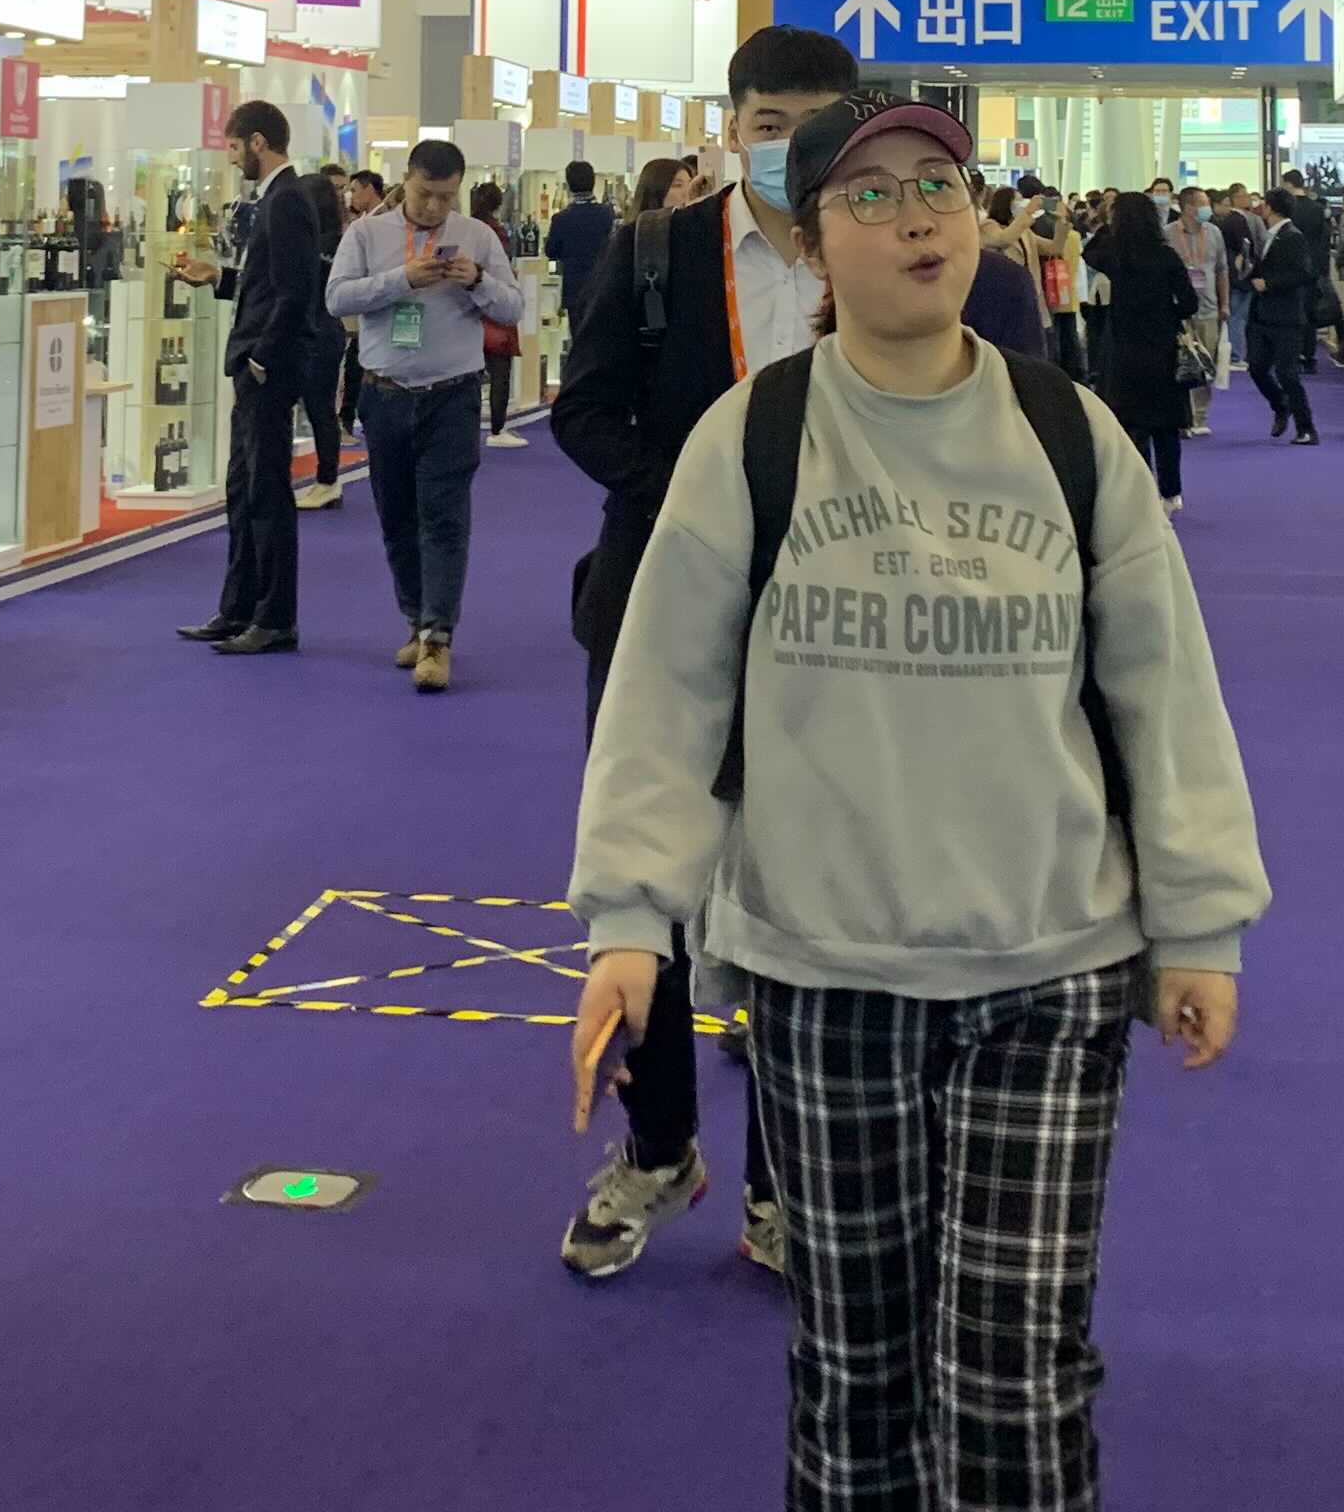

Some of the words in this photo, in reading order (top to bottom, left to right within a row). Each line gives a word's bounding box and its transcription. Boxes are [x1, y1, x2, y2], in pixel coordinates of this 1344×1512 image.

[1095, 8, 1125, 18] EXIT
[1151, 0, 1258, 42] EXIT
[787, 485, 935, 566] MICHAEL
[947, 500, 1077, 574] SCOTT
[873, 550, 920, 577] EST.
[766, 580, 888, 650] PAPER
